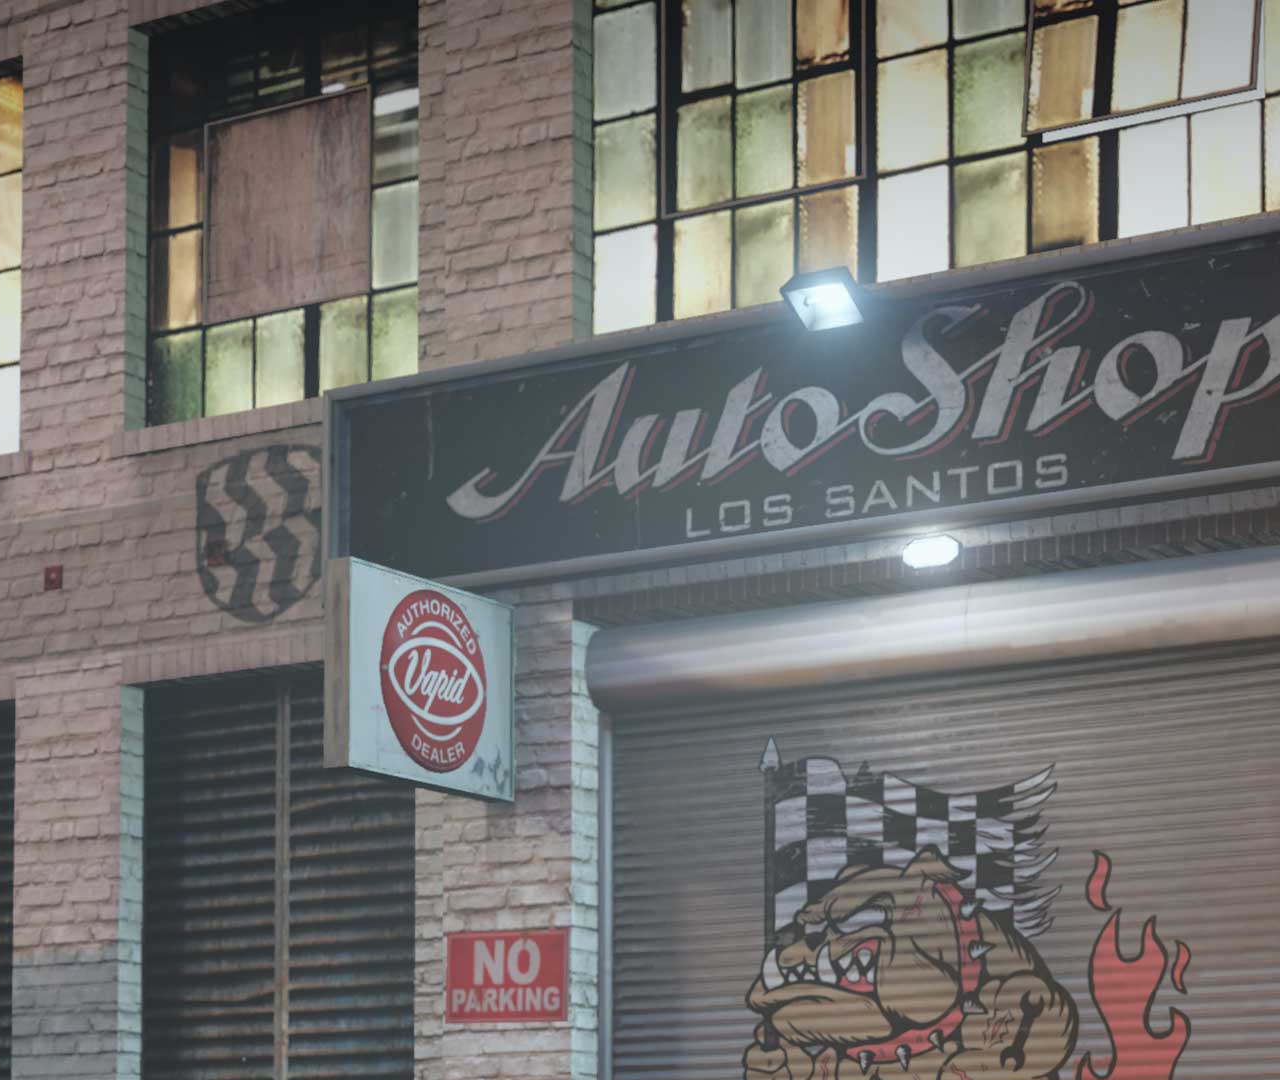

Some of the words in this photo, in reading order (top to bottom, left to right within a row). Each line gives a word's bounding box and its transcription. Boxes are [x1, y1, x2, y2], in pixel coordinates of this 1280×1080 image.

[684, 495, 794, 539] LOS
[825, 452, 1069, 518] SANTOS
[396, 597, 478, 655] AUTHORIZED
[404, 648, 470, 713] Vapid
[411, 733, 465, 764] DEALER
[473, 938, 541, 986] NO
[451, 986, 561, 1013] PARKING
